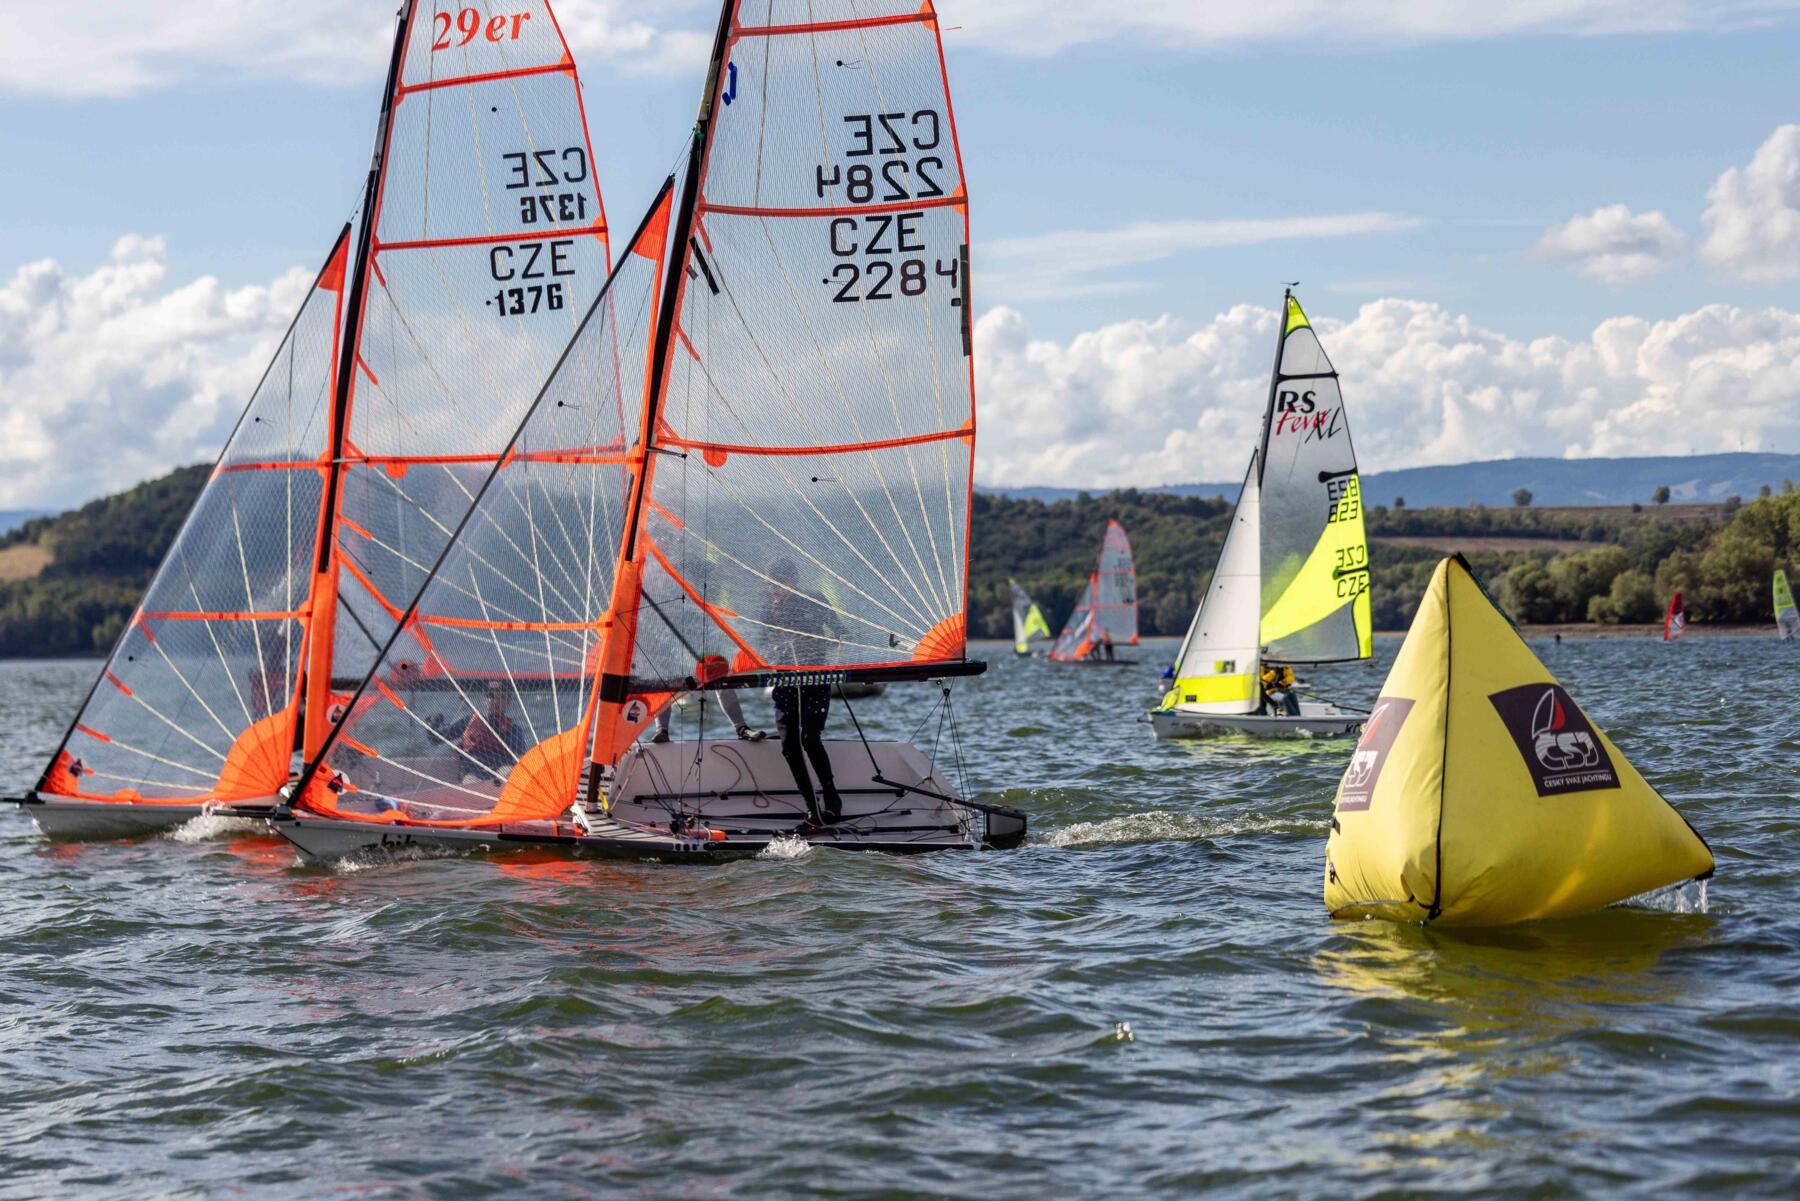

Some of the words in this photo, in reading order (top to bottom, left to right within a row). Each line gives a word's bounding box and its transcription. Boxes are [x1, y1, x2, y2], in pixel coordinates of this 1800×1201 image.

[431, 7, 531, 51] 29er
[830, 212, 926, 257] CZE
[490, 240, 576, 282] CZE
[832, 258, 958, 303] 2284
[494, 283, 564, 317] 1376
[1277, 390, 1317, 414] RS
[1336, 574, 1367, 598] CZE
